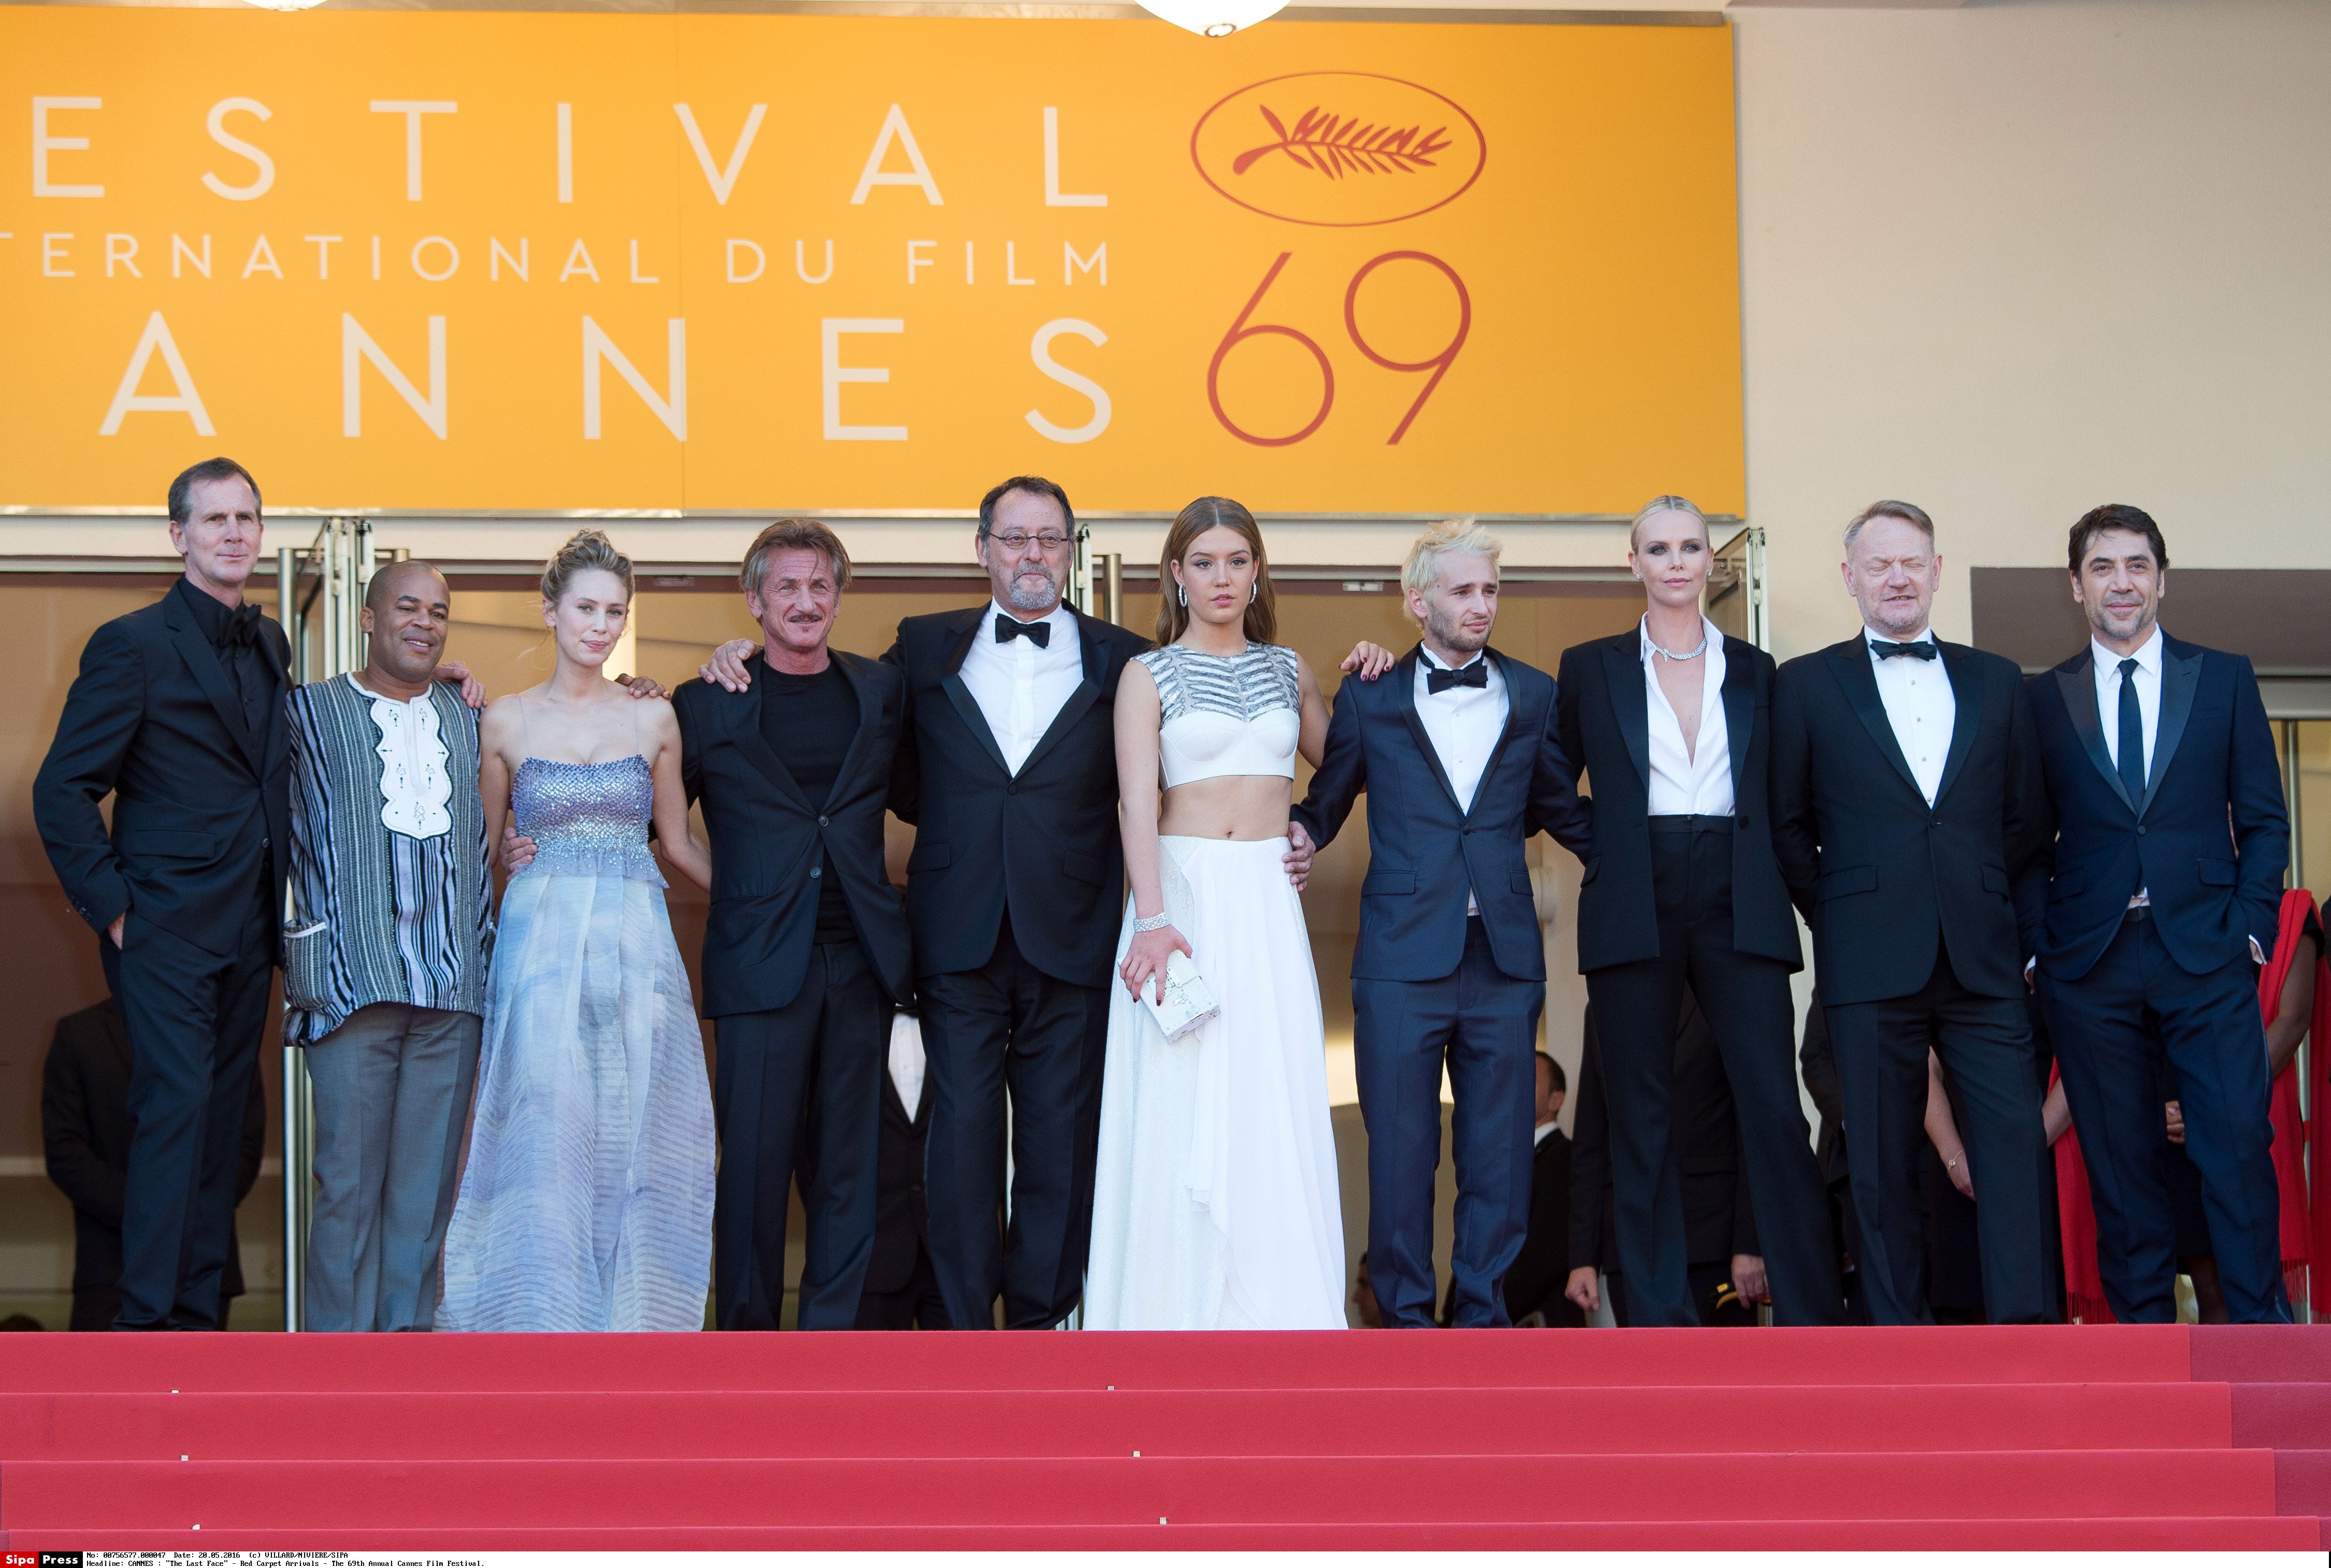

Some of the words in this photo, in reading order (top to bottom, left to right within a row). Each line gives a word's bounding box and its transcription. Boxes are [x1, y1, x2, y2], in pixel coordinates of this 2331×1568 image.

[726, 239, 834, 284] DU
[907, 240, 1107, 286] FILM
[98, 310, 1112, 444] ANNES
[1208, 251, 1471, 447] 69
